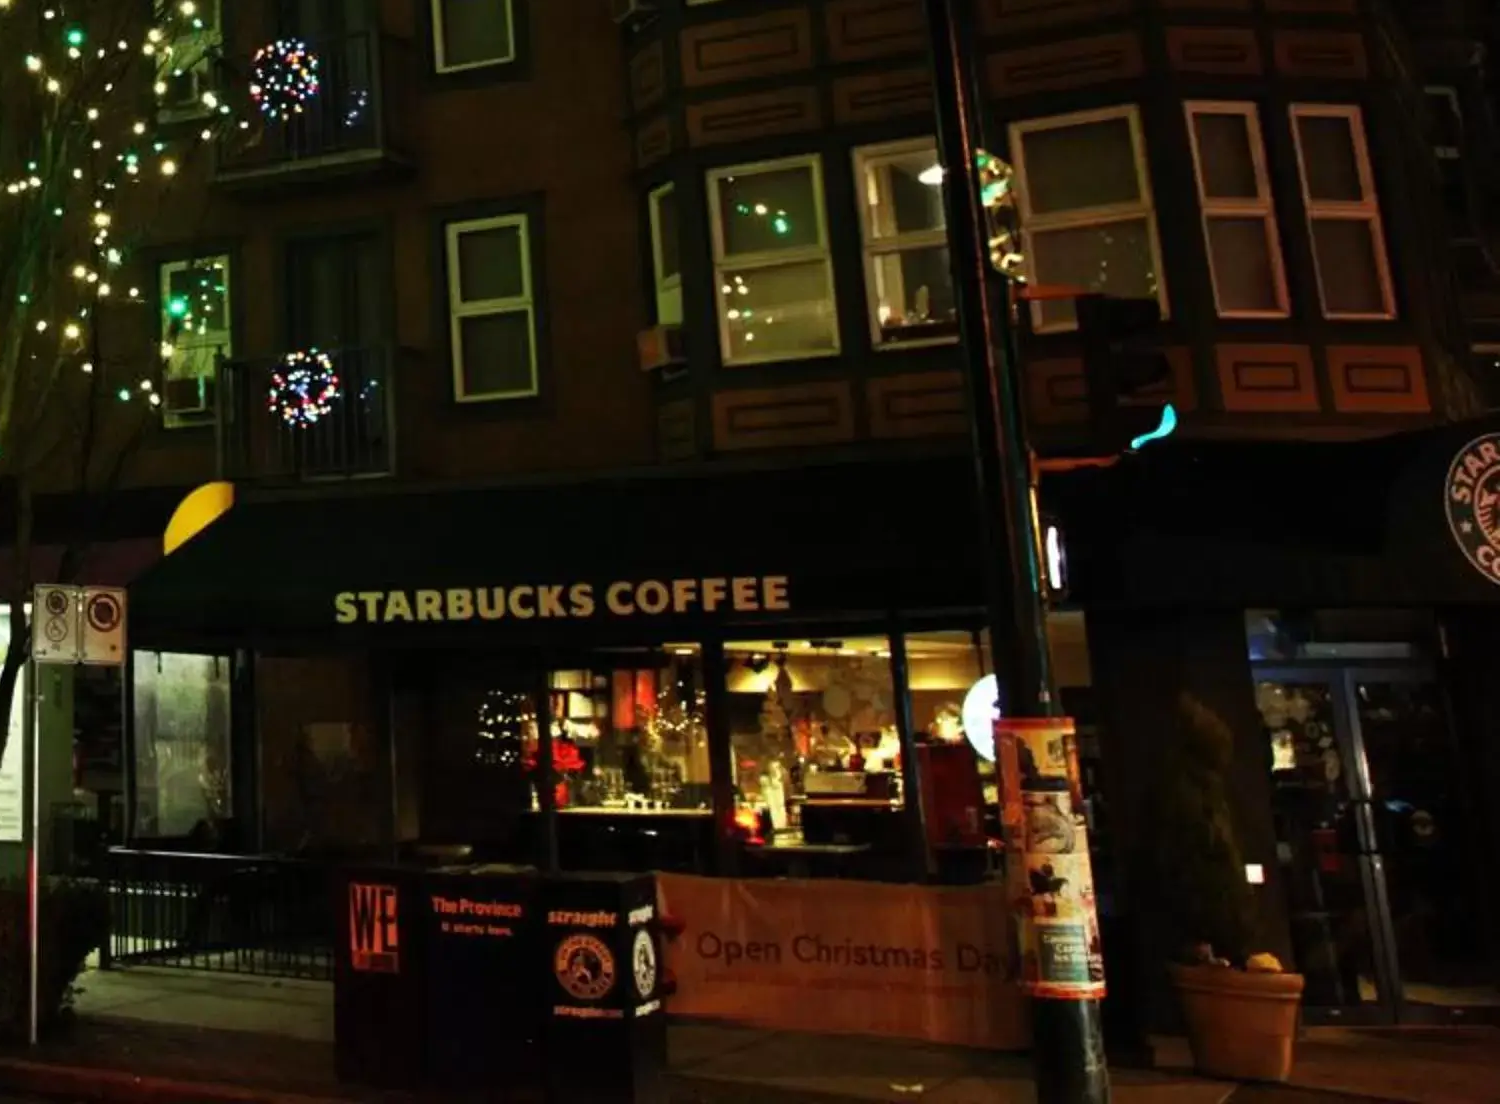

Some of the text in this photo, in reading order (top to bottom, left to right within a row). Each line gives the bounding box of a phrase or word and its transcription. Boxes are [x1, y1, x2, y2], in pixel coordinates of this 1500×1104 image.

[1451, 441, 1500, 505] STAR
[334, 575, 791, 624] STARBUCKS COFFEE
[431, 895, 523, 918] The Province
[696, 931, 782, 967] Open
[792, 934, 944, 970] Christmas
